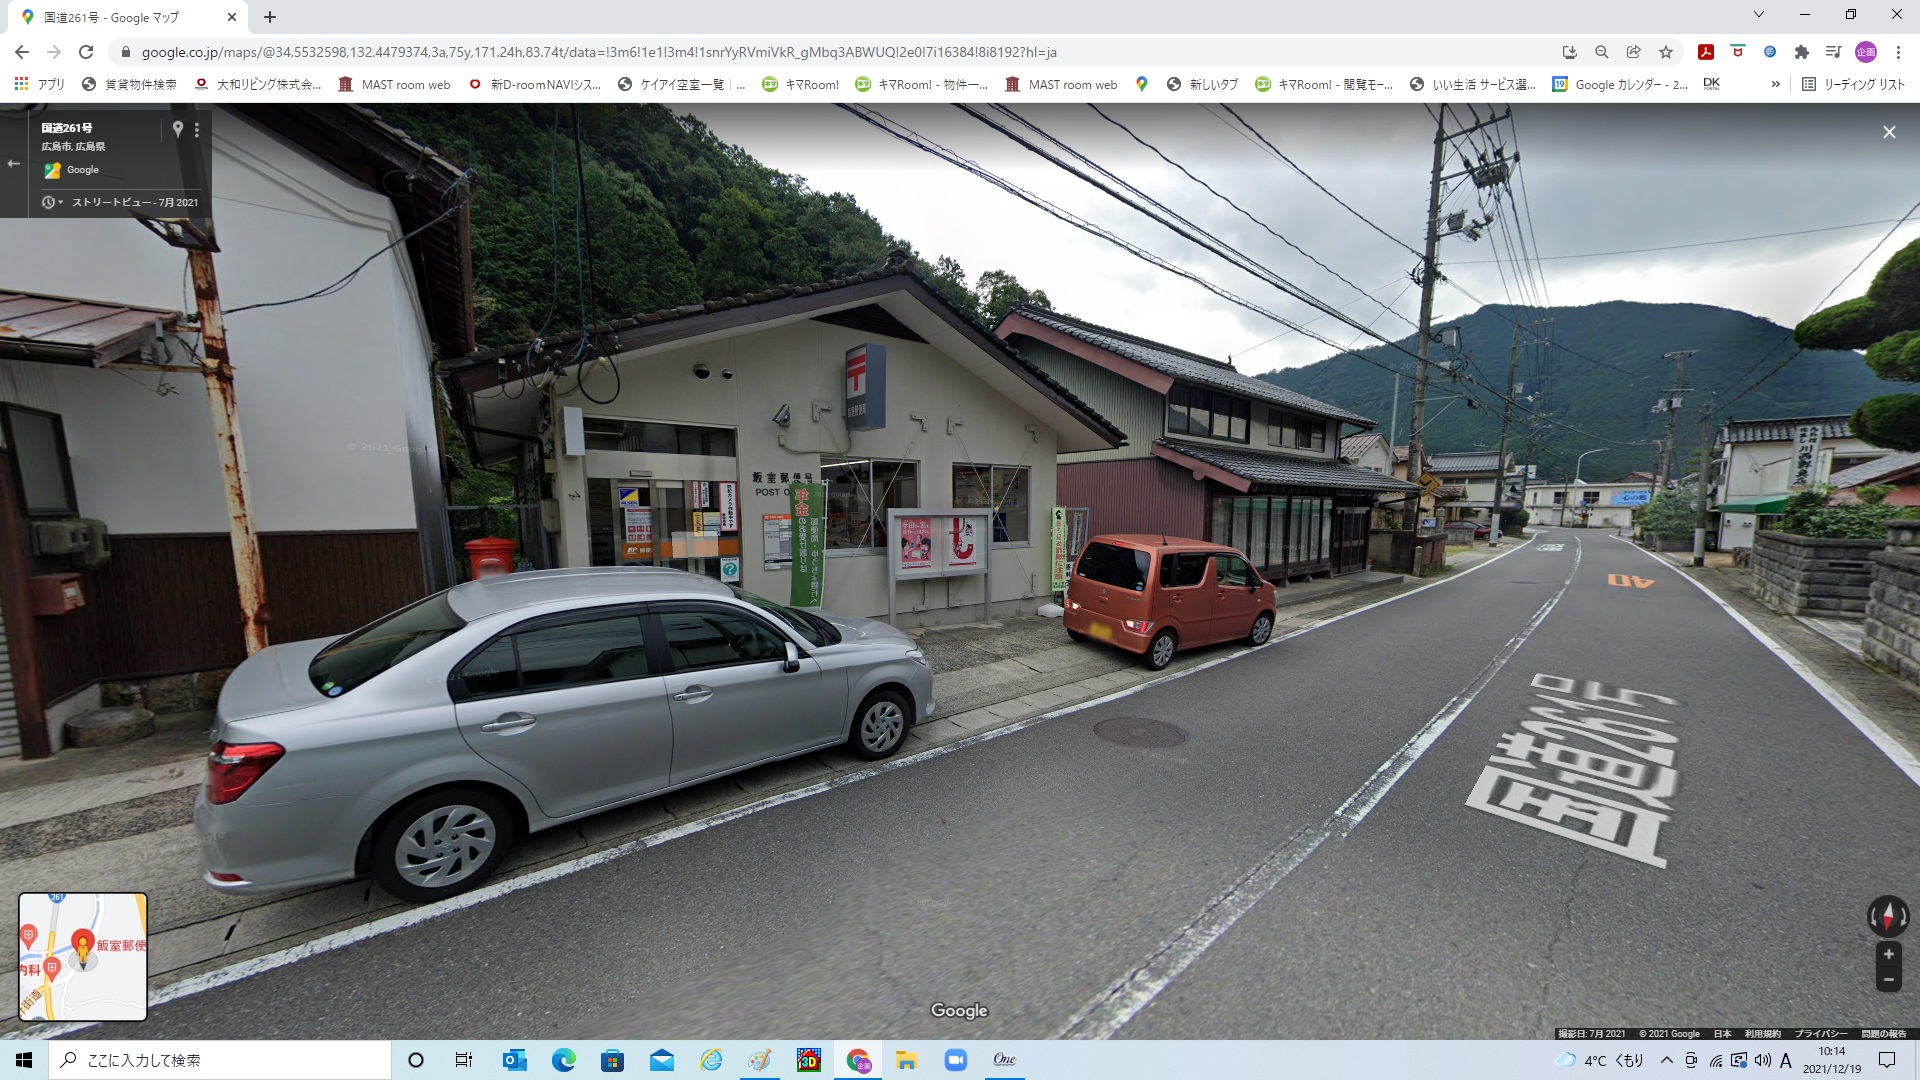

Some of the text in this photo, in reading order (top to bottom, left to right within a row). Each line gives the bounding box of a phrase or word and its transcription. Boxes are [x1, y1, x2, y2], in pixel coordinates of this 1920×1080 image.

[45, 12, 99, 23] 国道261号
[111, 13, 149, 25] Google
[153, 11, 179, 23] マップ
[1857, 46, 1876, 59] 企画
[39, 78, 64, 90] アプリ
[106, 79, 176, 90] 賃貸物件検索
[363, 80, 393, 89] MAST
[428, 80, 450, 89] web
[786, 79, 838, 90] キマRoom!
[879, 79, 931, 90] キマRoom!
[1030, 80, 1060, 89] MAST
[1095, 80, 1117, 89] web
[1190, 78, 1238, 90] 新しいタブ
[1279, 79, 1331, 90] キマRoom!
[1434, 79, 1476, 90] いい生活
[1556, 79, 1565, 89] 19
[1576, 80, 1614, 92] Google
[1618, 78, 1661, 90] カレンダー
[1704, 78, 1720, 86] DK
[1826, 78, 1905, 90] リーディング リスト
[753, 472, 813, 484] 飯室郵便局
[756, 488, 780, 496] POST
[1607, 573, 1656, 590] 40
[1464, 672, 1681, 869] 国道261号
[1819, 1047, 1845, 1055] 10:14
[89, 1054, 200, 1067] ここに入力して検索
[1616, 1054, 1642, 1067] くもり
[1780, 1053, 1792, 1068] A
[1803, 1064, 1861, 1074] 2021/12/19
